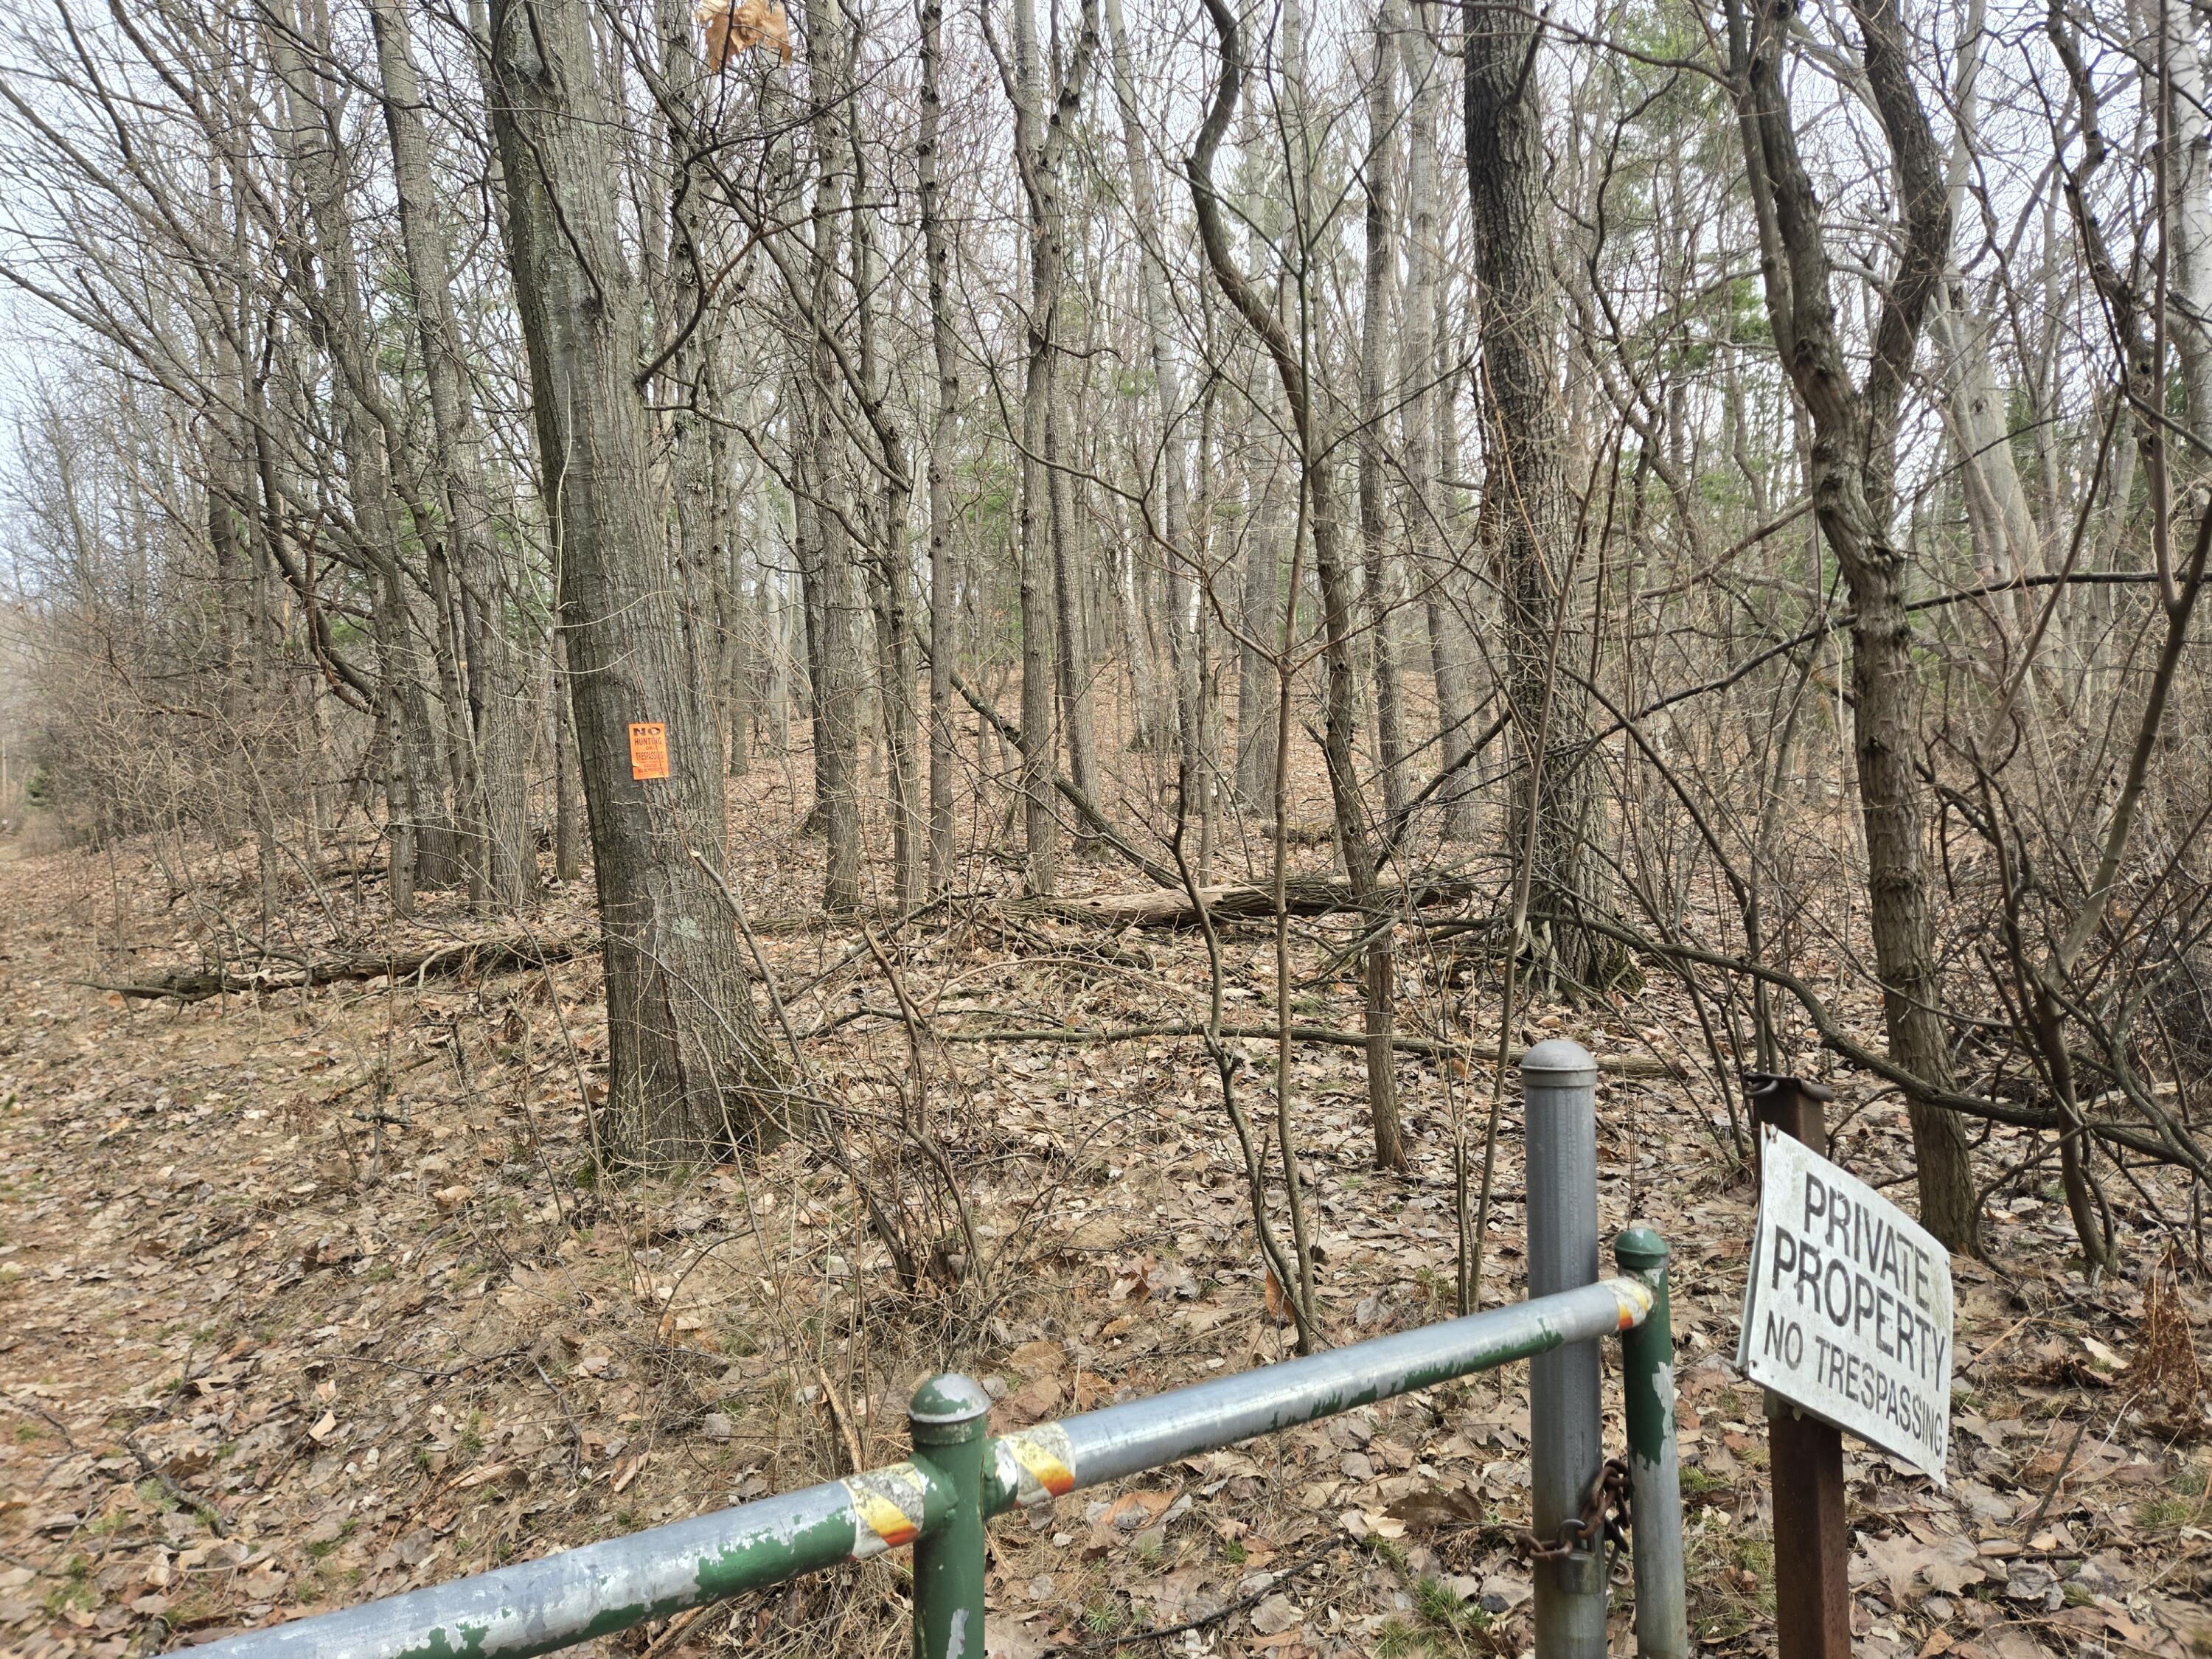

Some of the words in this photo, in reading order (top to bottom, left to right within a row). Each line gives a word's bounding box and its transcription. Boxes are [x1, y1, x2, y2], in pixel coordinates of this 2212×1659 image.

[633, 727, 661, 737] NO
[634, 737, 662, 745] HUNTING
[636, 751, 664, 761] TRESPASSIG
[1804, 1171, 1930, 1313] PRIVATE
[1771, 1225, 1946, 1393] PROPERTY
[1764, 1310, 1804, 1371] NO
[1815, 1335, 1943, 1458] TRESPASSING
